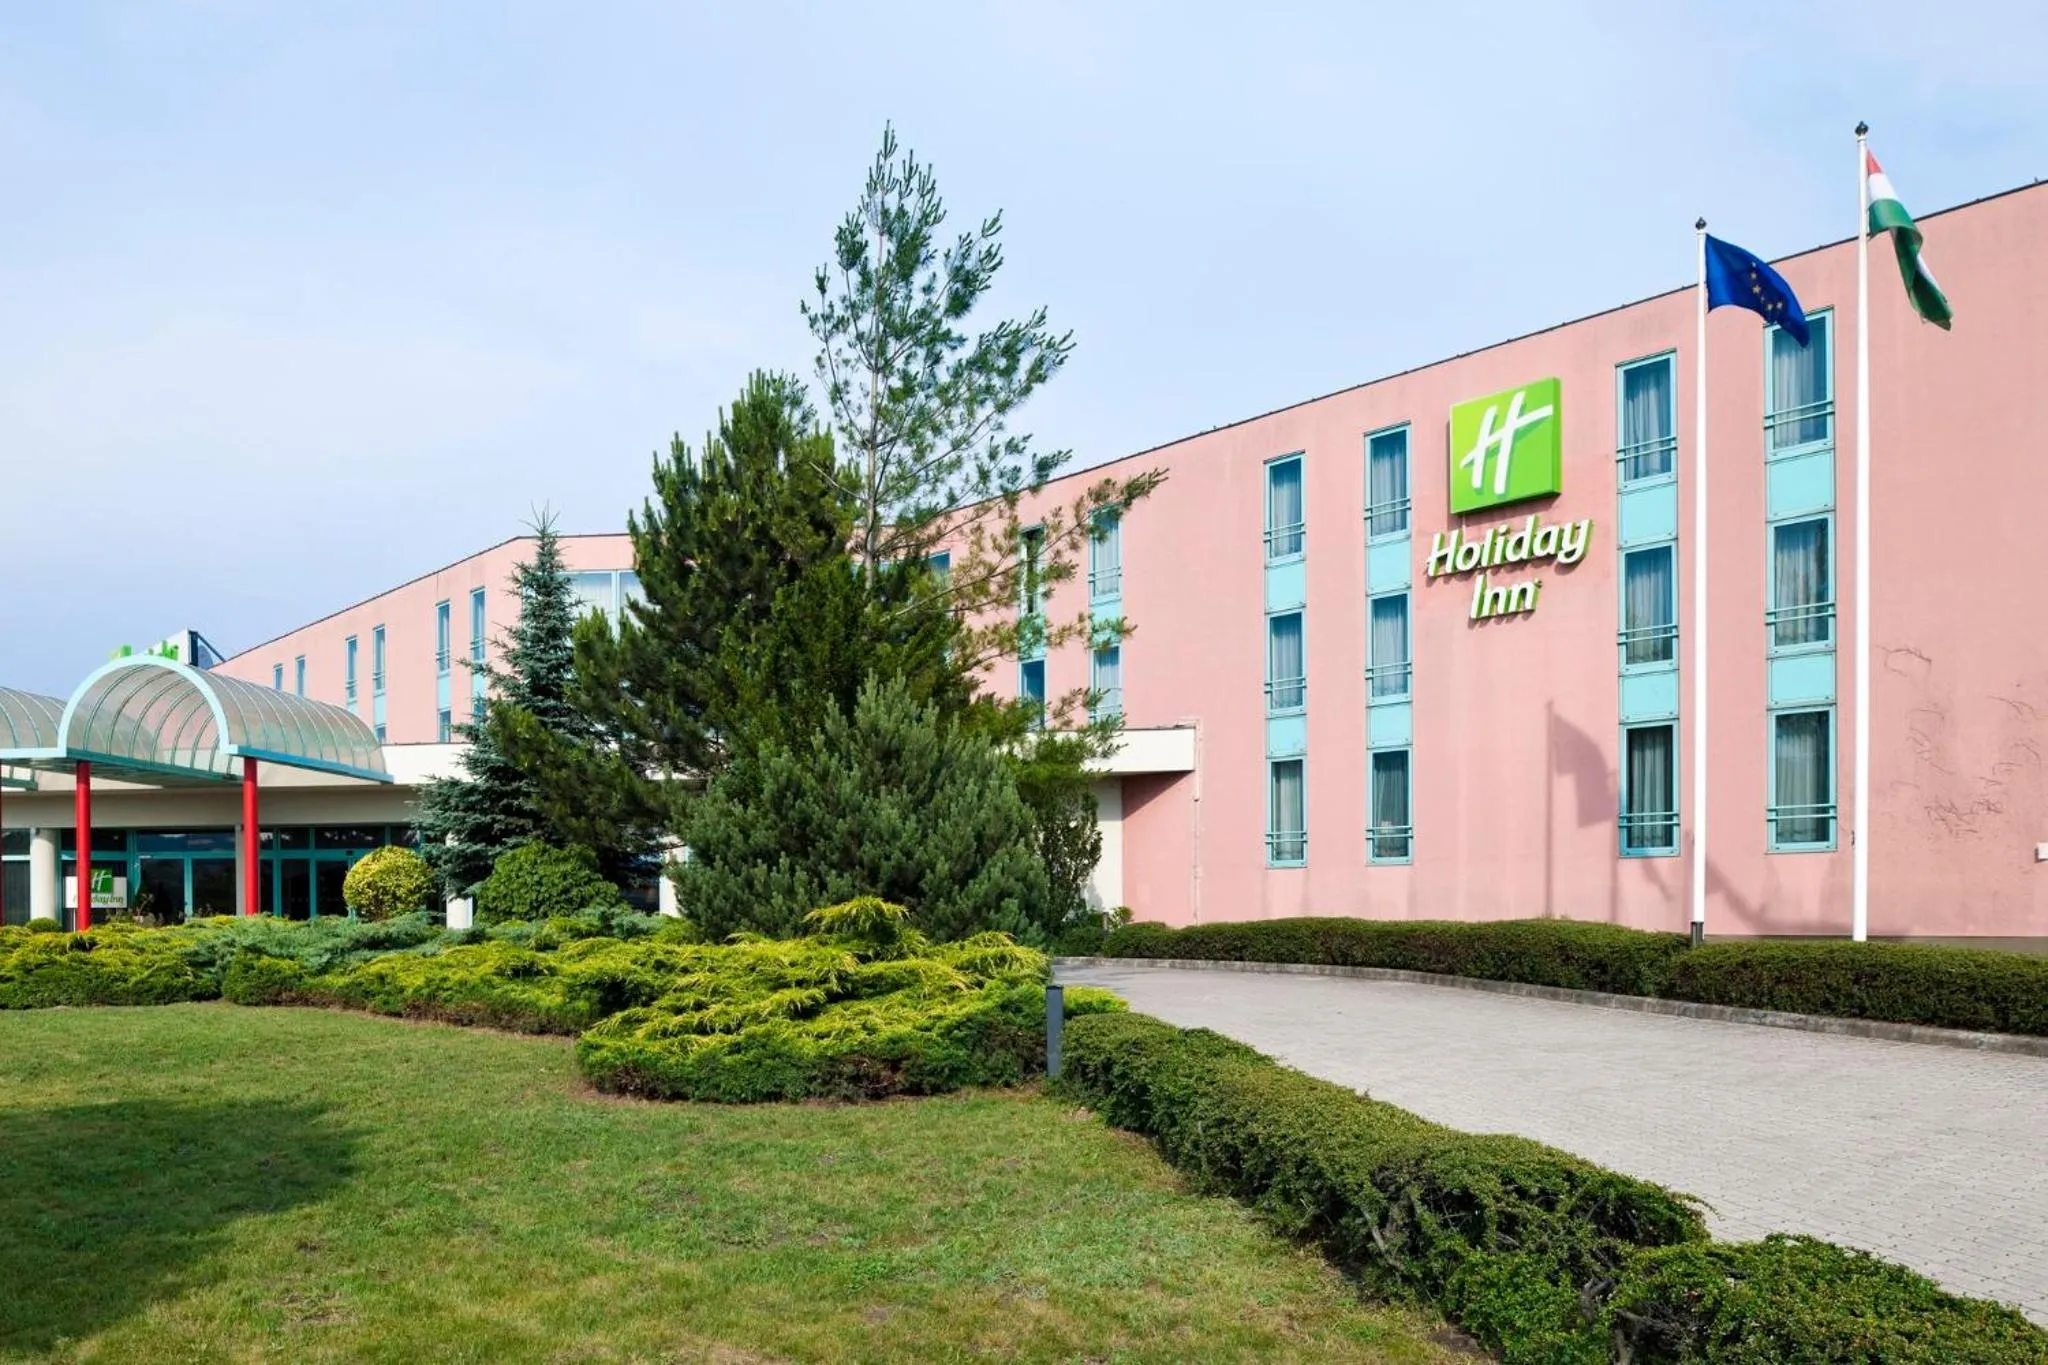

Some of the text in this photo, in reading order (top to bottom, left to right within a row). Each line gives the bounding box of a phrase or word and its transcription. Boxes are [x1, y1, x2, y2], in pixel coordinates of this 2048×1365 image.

[1459, 391, 1553, 494] H
[1427, 514, 1593, 577] Holiday
[1470, 573, 1537, 619] Inn
